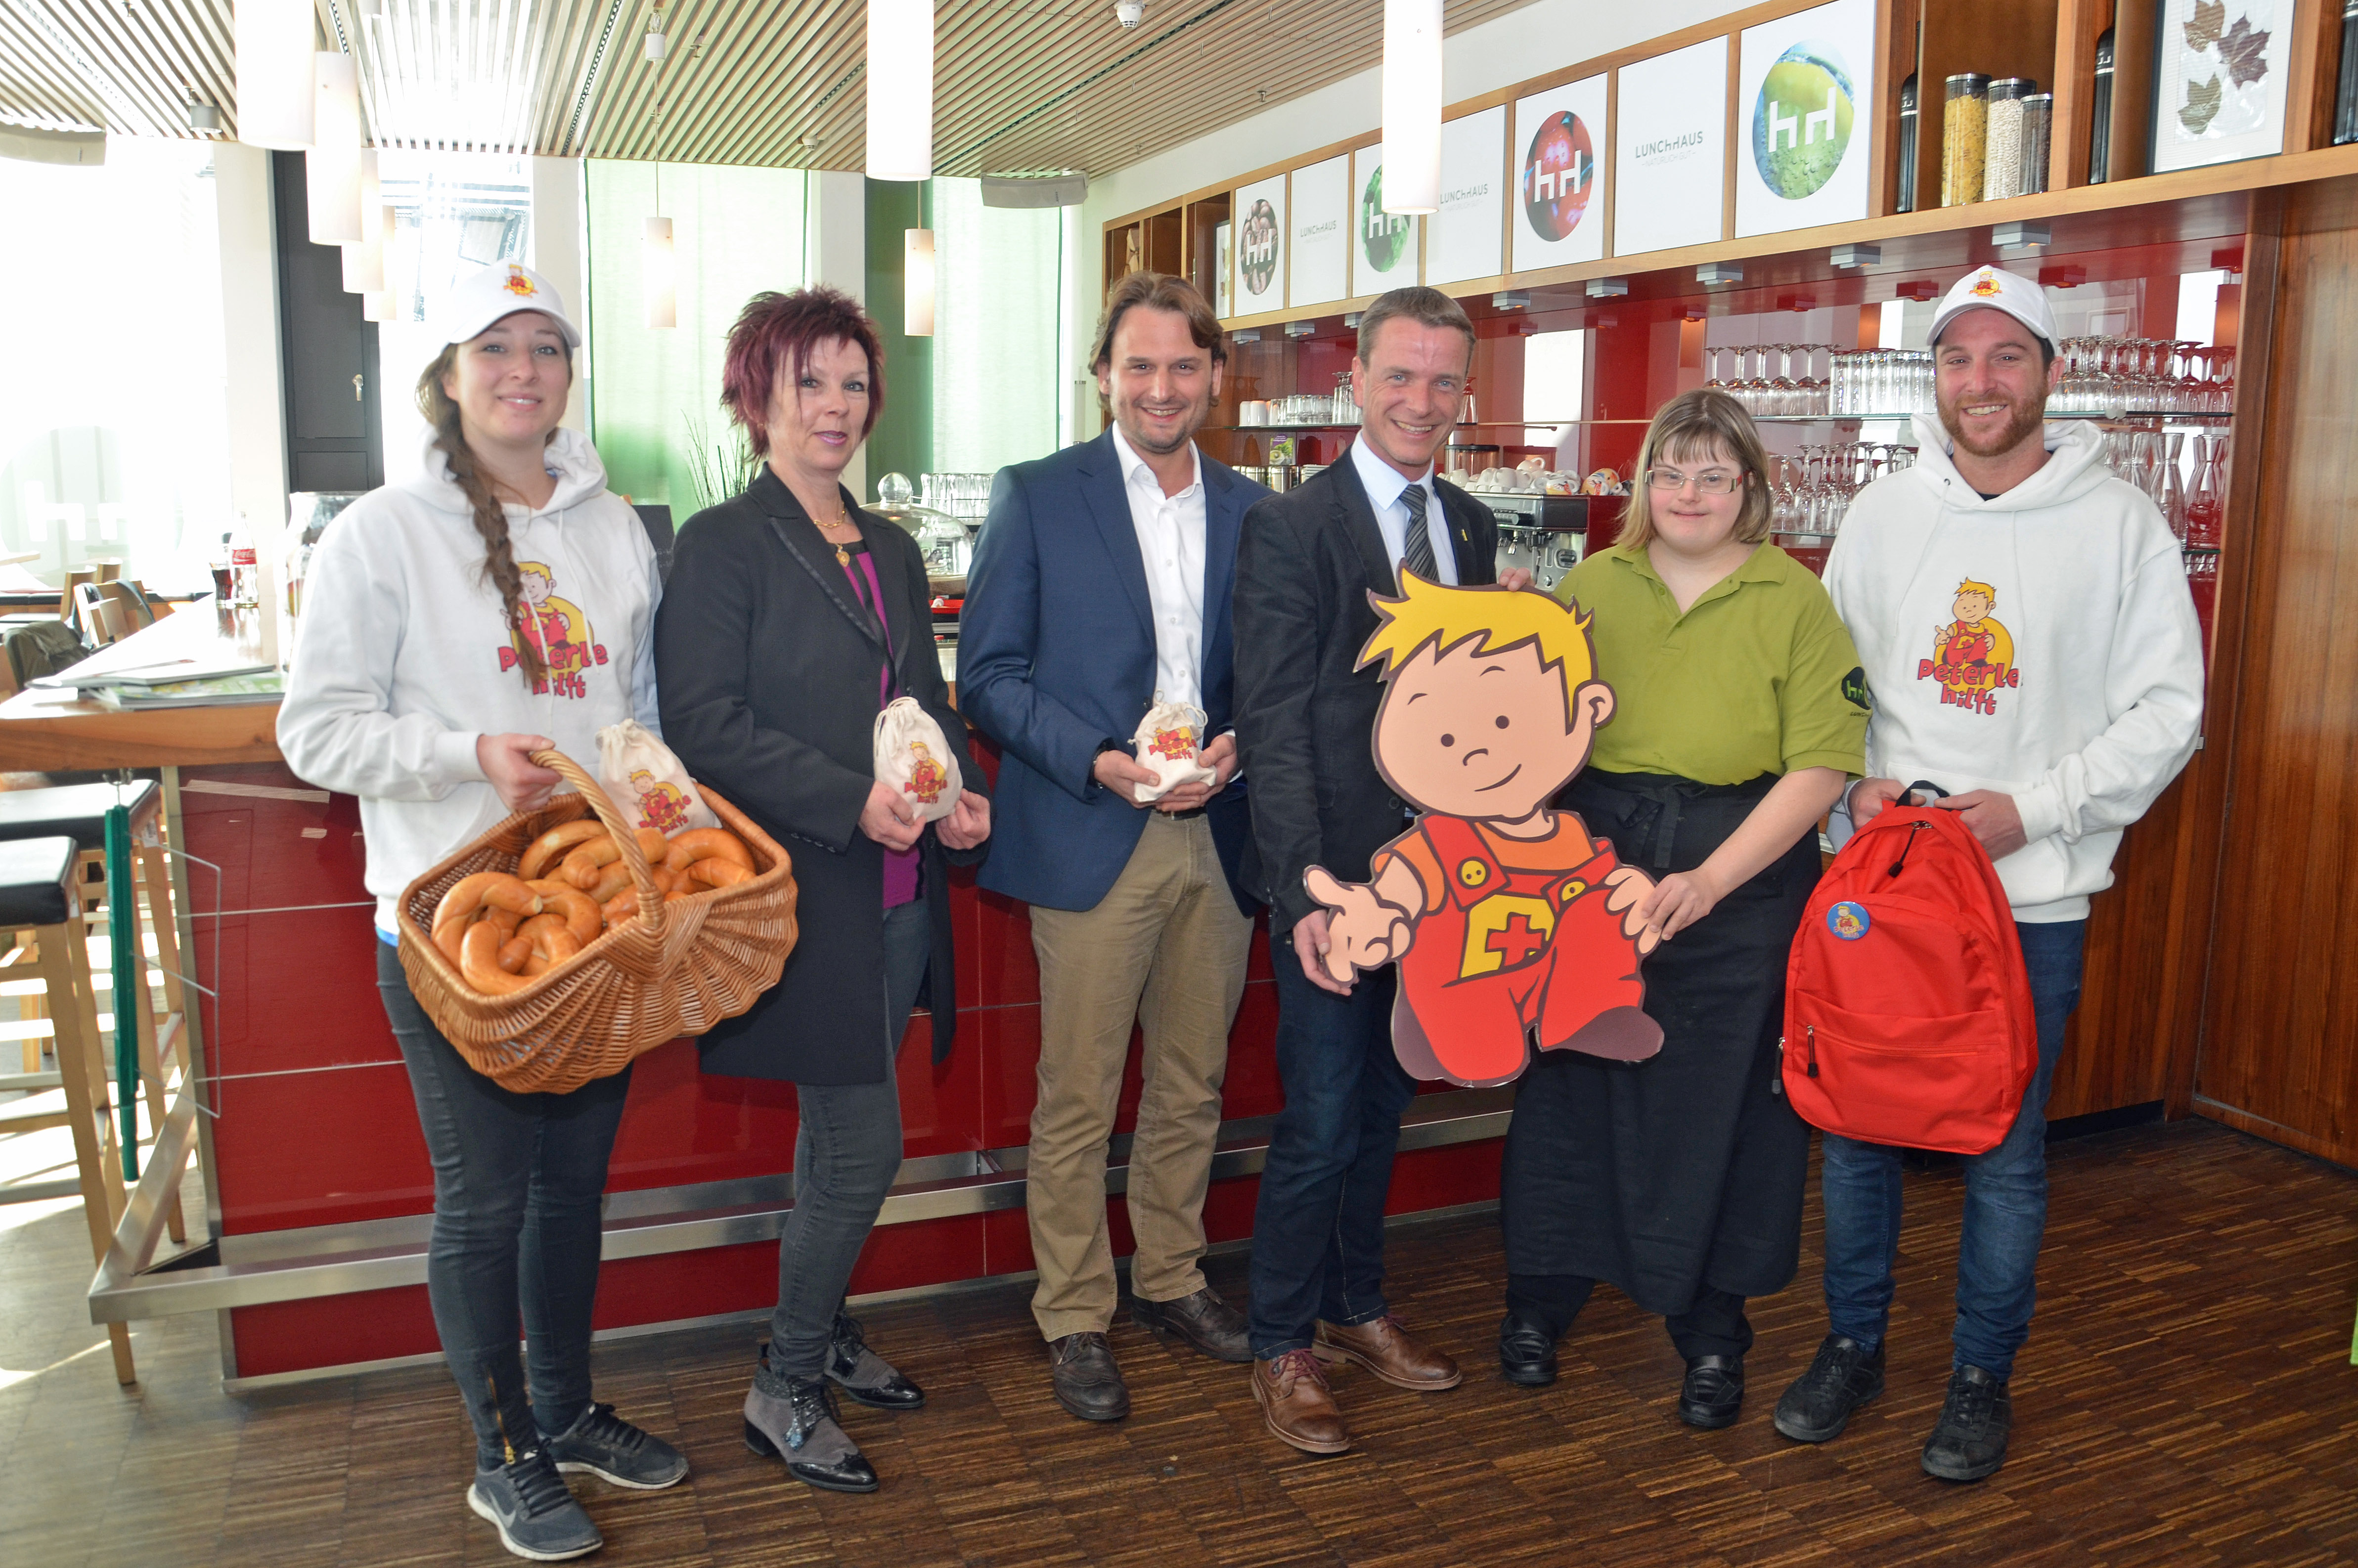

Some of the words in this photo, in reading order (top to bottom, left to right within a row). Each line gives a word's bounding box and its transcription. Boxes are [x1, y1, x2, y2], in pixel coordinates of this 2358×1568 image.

[497, 641, 609, 672] Perle
[1917, 658, 2019, 688] Peterle
[1940, 684, 1998, 715] hilft
